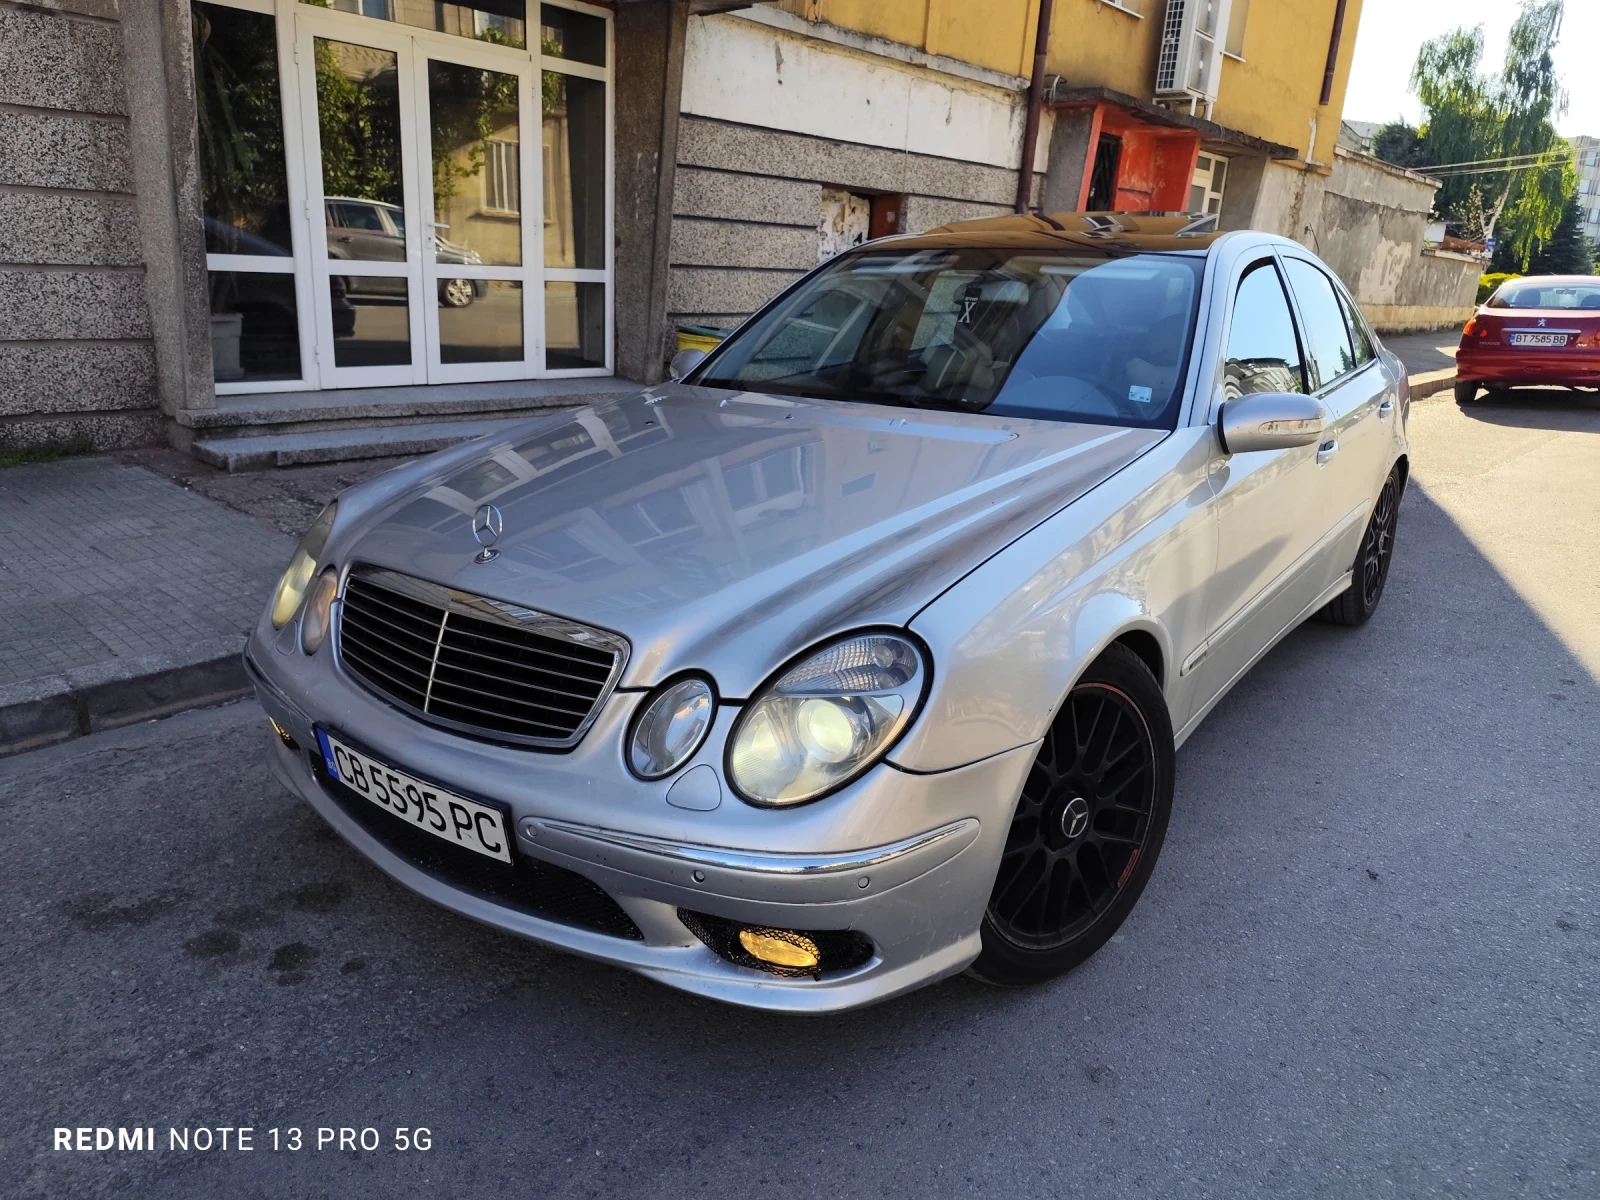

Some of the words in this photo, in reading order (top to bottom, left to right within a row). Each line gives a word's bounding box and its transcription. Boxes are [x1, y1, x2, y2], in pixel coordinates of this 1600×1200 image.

[958, 301, 977, 323] X
[1515, 334, 1528, 343] BT
[1553, 335, 1566, 344] BB
[334, 745, 370, 793] CB
[369, 764, 446, 832] 5595
[449, 801, 502, 854] PC
